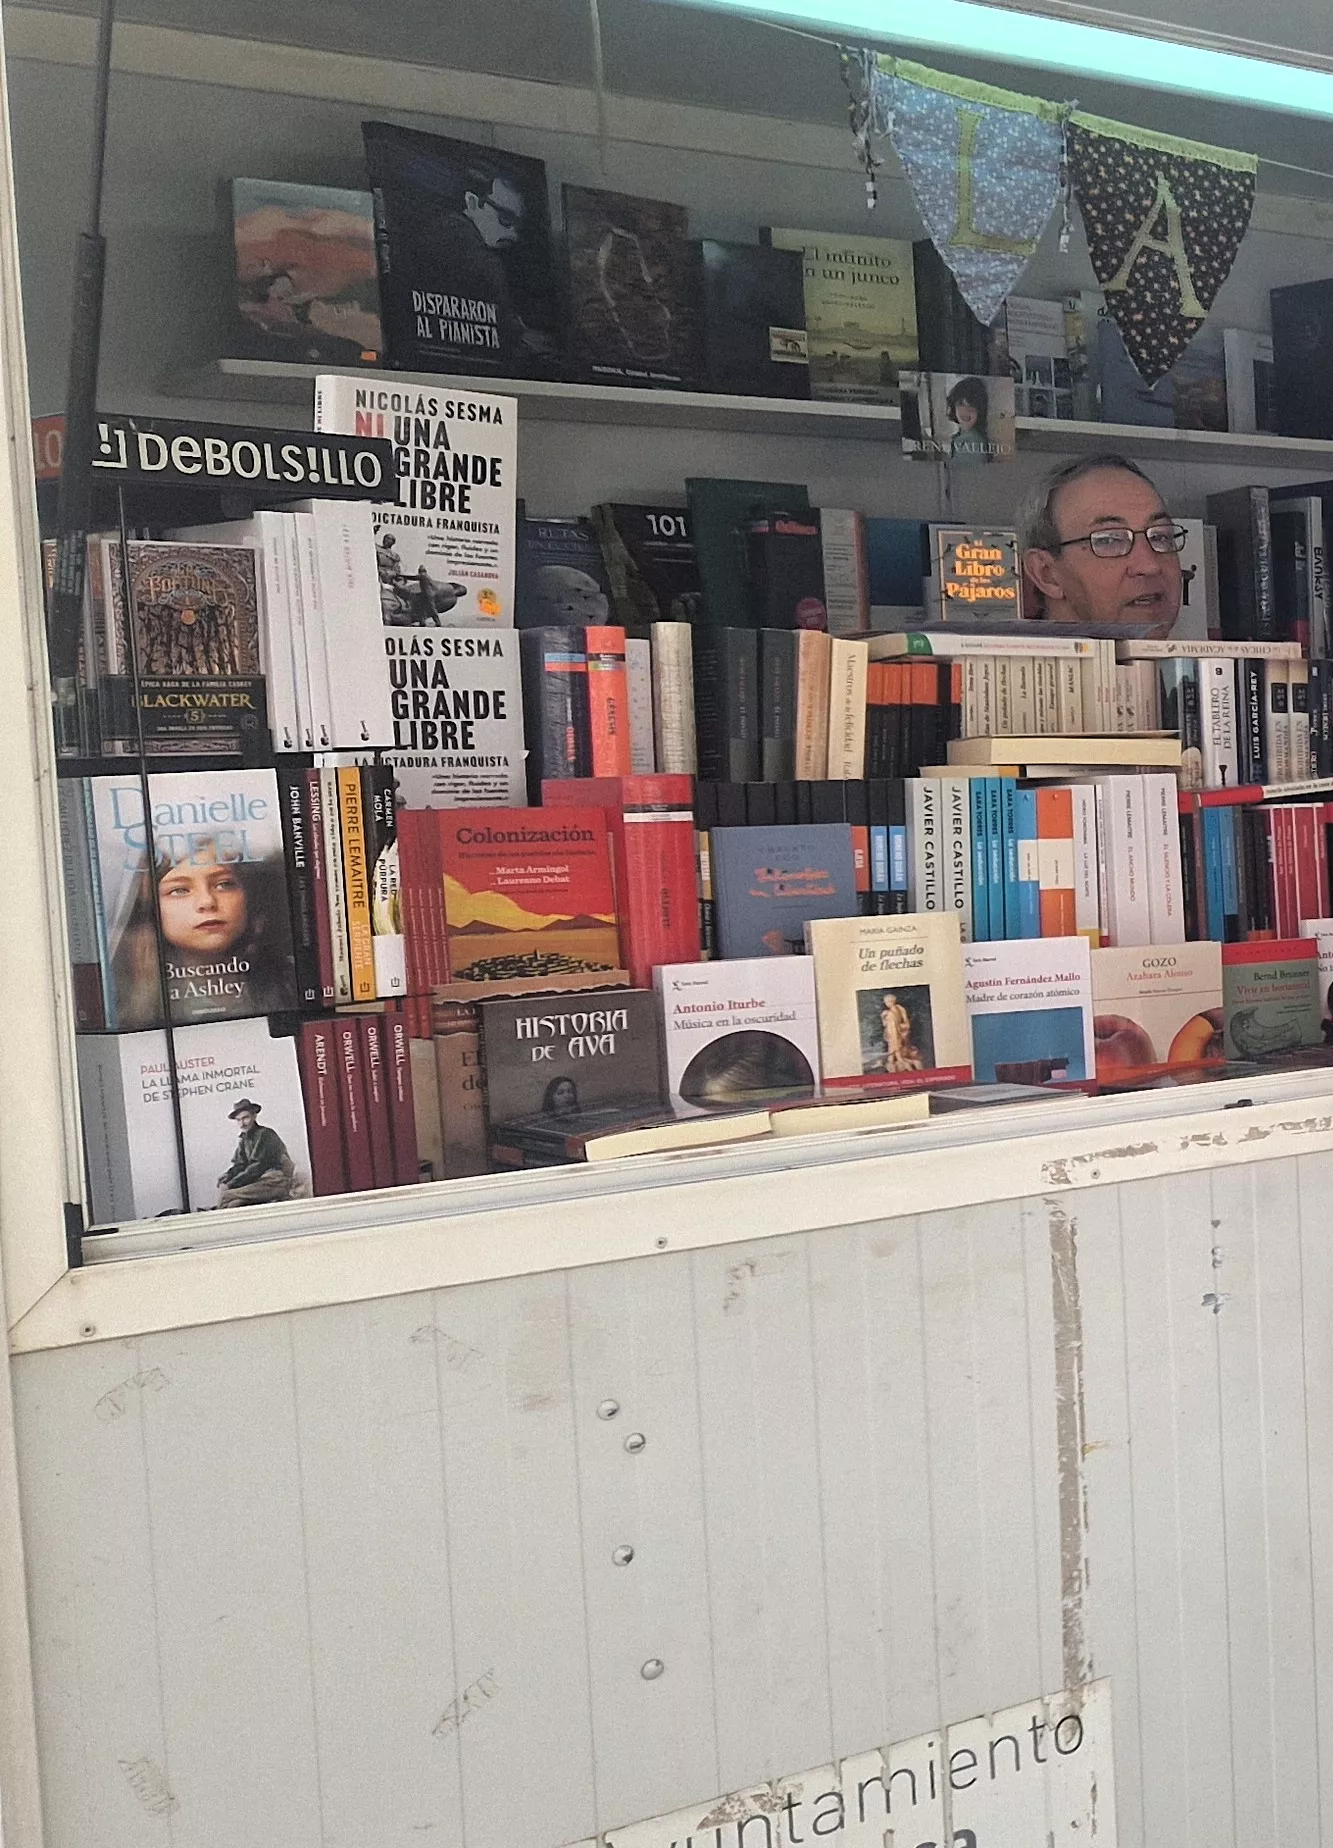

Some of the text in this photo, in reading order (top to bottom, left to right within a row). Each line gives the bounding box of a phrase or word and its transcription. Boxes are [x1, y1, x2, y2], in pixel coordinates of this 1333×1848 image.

[826, 249, 892, 267] infinito
[822, 267, 900, 288] un junco
[412, 290, 497, 323] DISPARARON
[416, 315, 500, 348] AL PIANISTA
[355, 389, 503, 425] NICOLÁS SESMA
[355, 411, 450, 450] NI UNA
[394, 447, 503, 488] GRANDE
[394, 478, 471, 514] LIBRE
[436, 519, 500, 534] FRANQUISTA
[645, 514, 687, 537] 101
[955, 543, 1002, 560] Gran
[955, 560, 1005, 577] Libro
[946, 582, 1016, 602] Pájaros
[385, 635, 503, 657] OLÁS SESMA
[389, 659, 450, 689] UNA
[844, 652, 857, 694] Maestros
[391, 690, 507, 721] GRANDE
[1210, 688, 1222, 747] EL TABLERO
[1221, 685, 1232, 750] DE LA REINA
[1250, 671, 1262, 759] LUIS GARCÍA-REY
[393, 720, 476, 750] LIBRE
[441, 755, 509, 768] FRANQUISTA
[109, 786, 268, 830] Danielle
[289, 785, 300, 815] JOHN
[309, 781, 321, 822] LESSING
[374, 794, 382, 822] MOLA
[383, 789, 394, 828] CARMEN
[123, 825, 264, 874] STEEL
[291, 816, 305, 868] BANVILLE
[345, 784, 366, 908] PIERRE LEMAITRE
[456, 826, 595, 845] Colonización
[923, 786, 936, 910] JAVIER CASTILLO
[951, 786, 964, 909] JAVIER CASTILLO
[379, 858, 388, 902] PÚRPURA
[389, 864, 398, 896] LA RED
[495, 865, 569, 875] Marta Armingol
[543, 875, 570, 884] Debat
[858, 944, 925, 961] Un puñado
[861, 957, 924, 973] de flechas
[1142, 956, 1177, 968] GOZO
[165, 957, 251, 980] Buscando
[965, 971, 1081, 991] Agustín Fernández Mallo
[1126, 966, 1194, 981] Azahara Alonso
[1253, 968, 1310, 982] Bernd Brunner
[169, 980, 246, 1001] a Ashley
[966, 986, 1081, 1004] Madre de corazón atómico
[1236, 984, 1262, 996] Vivir
[1264, 985, 1273, 994] en
[673, 998, 765, 1015] Antonio Iturbe
[673, 1011, 797, 1031] Música en la oscuridad
[515, 1008, 628, 1041] HISTORIA
[314, 1034, 328, 1075] ARENDT
[342, 1031, 355, 1071] ORWELL
[367, 1026, 380, 1068] ORWELL
[393, 1024, 406, 1065] ORWELL
[532, 1029, 616, 1062] DE AVA
[140, 1056, 216, 1076] PAUL AUSTER
[141, 1076, 157, 1090] LA
[202, 1064, 260, 1083] INMORTAL
[143, 1090, 161, 1104] DE
[216, 1077, 256, 1093] CRANE
